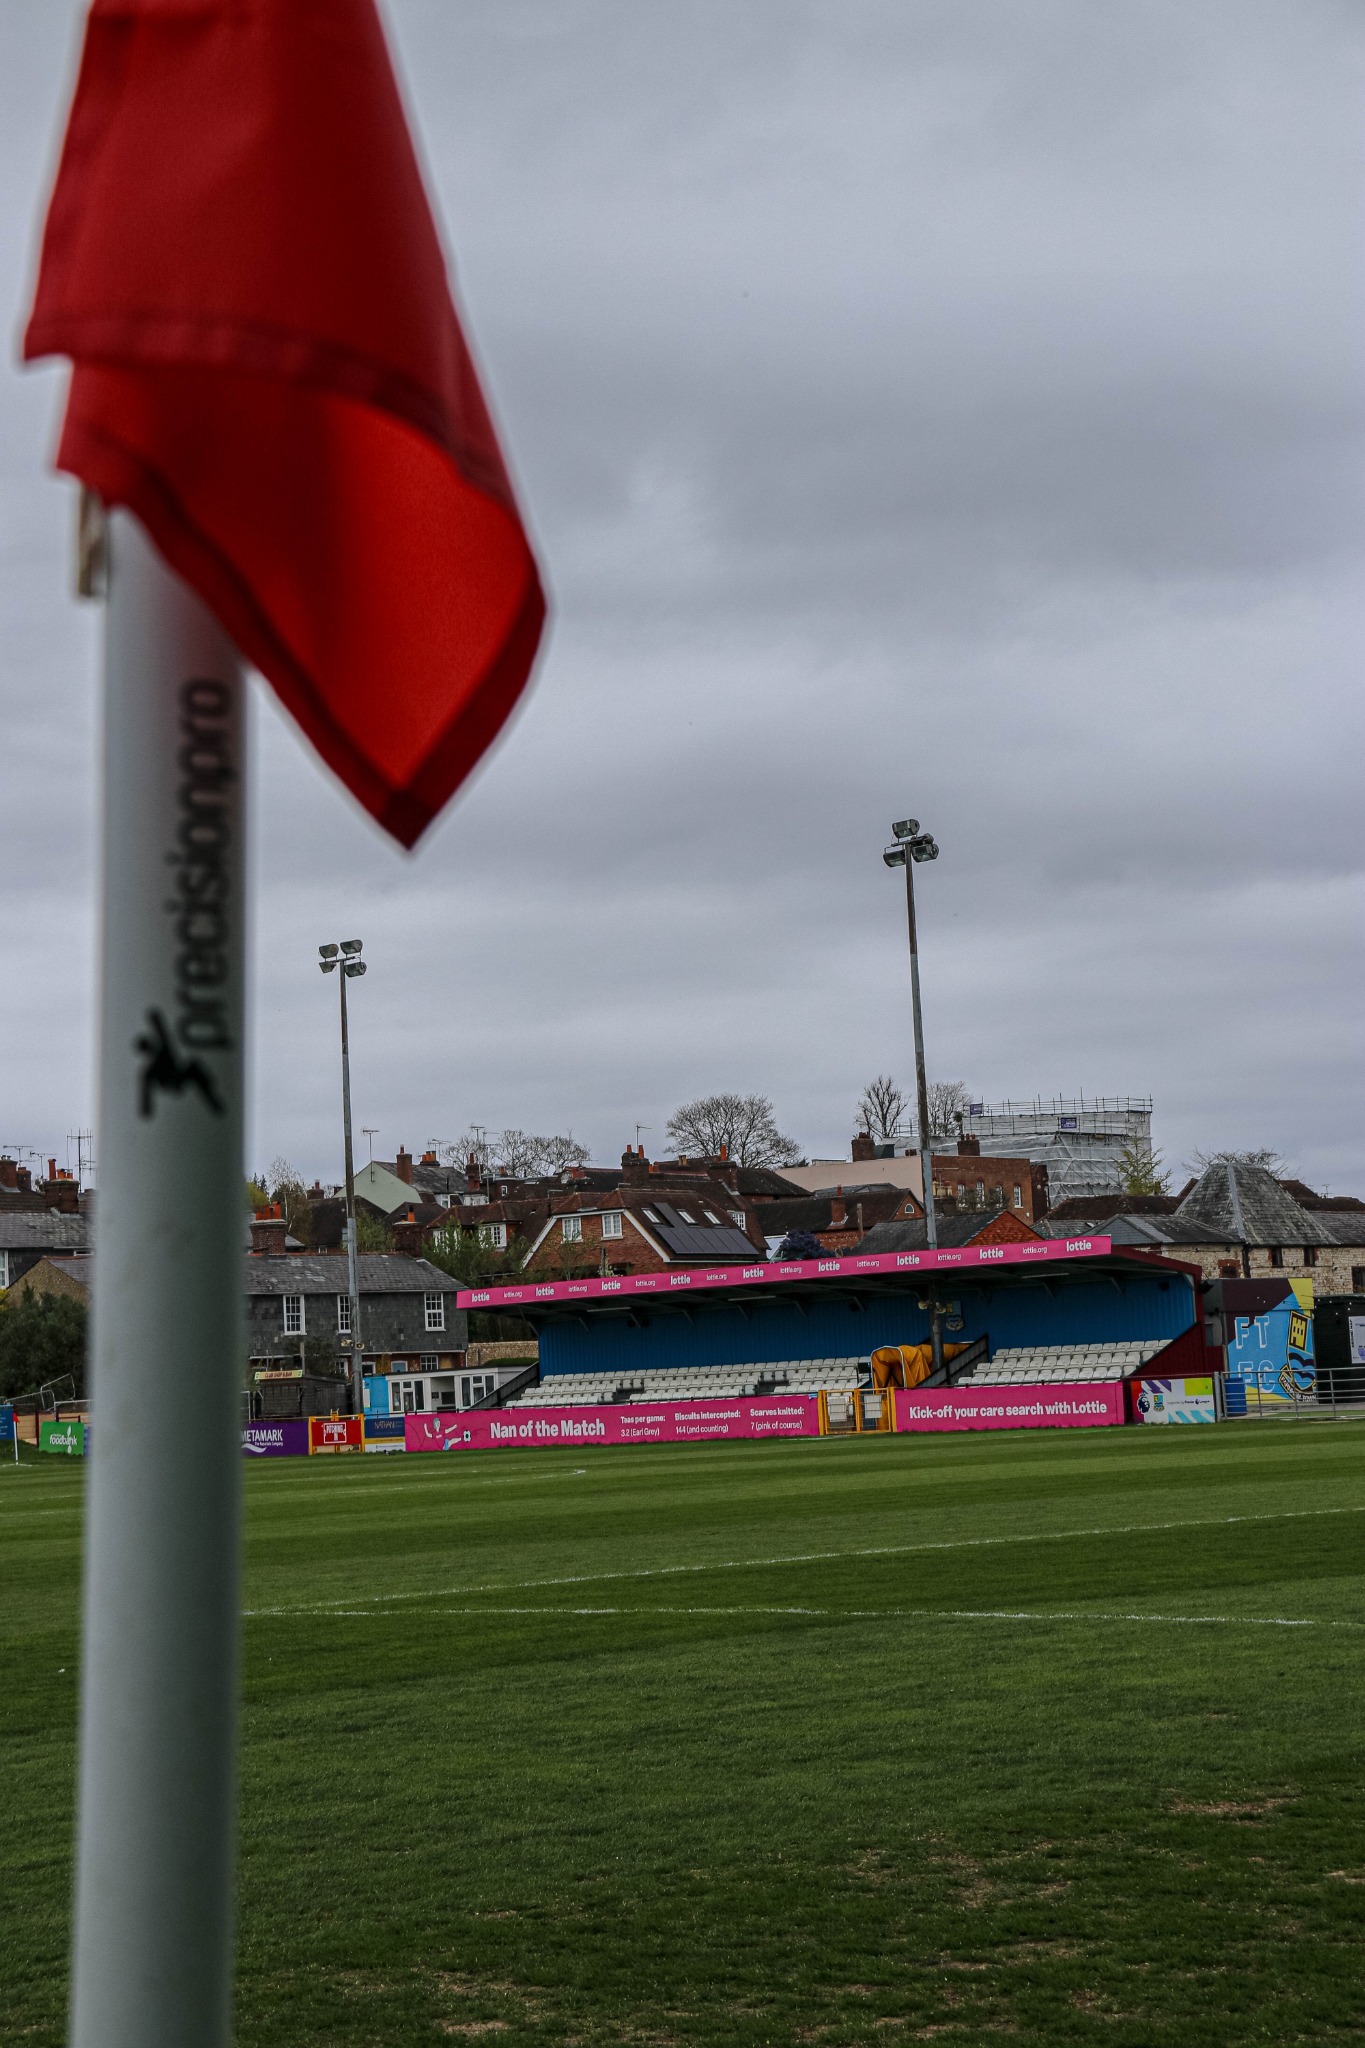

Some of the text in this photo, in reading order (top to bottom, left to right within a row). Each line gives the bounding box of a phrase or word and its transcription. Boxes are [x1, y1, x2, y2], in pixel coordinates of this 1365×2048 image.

[472, 1292, 490, 1302] lottie
[536, 1286, 554, 1296] lottie
[602, 1280, 620, 1290] lottie
[671, 1275, 690, 1285] lottie
[743, 1268, 764, 1278] lottie
[819, 1261, 840, 1272] lottie
[857, 1260, 879, 1268] lottie.org
[897, 1254, 919, 1265] lottie
[980, 1248, 1003, 1259] lottie
[1023, 1247, 1047, 1255] lottie.org
[1067, 1240, 1091, 1251] lottie
[675, 1410, 740, 1420] Biscuits intercepted:
[778, 1407, 804, 1415] knitted:
[910, 1401, 1107, 1420] Kick-off your care search with Lottie
[491, 1419, 605, 1438] Nan of the Match
[49, 1434, 77, 1445] foodbank
[239, 1429, 283, 1441] METAMARK
